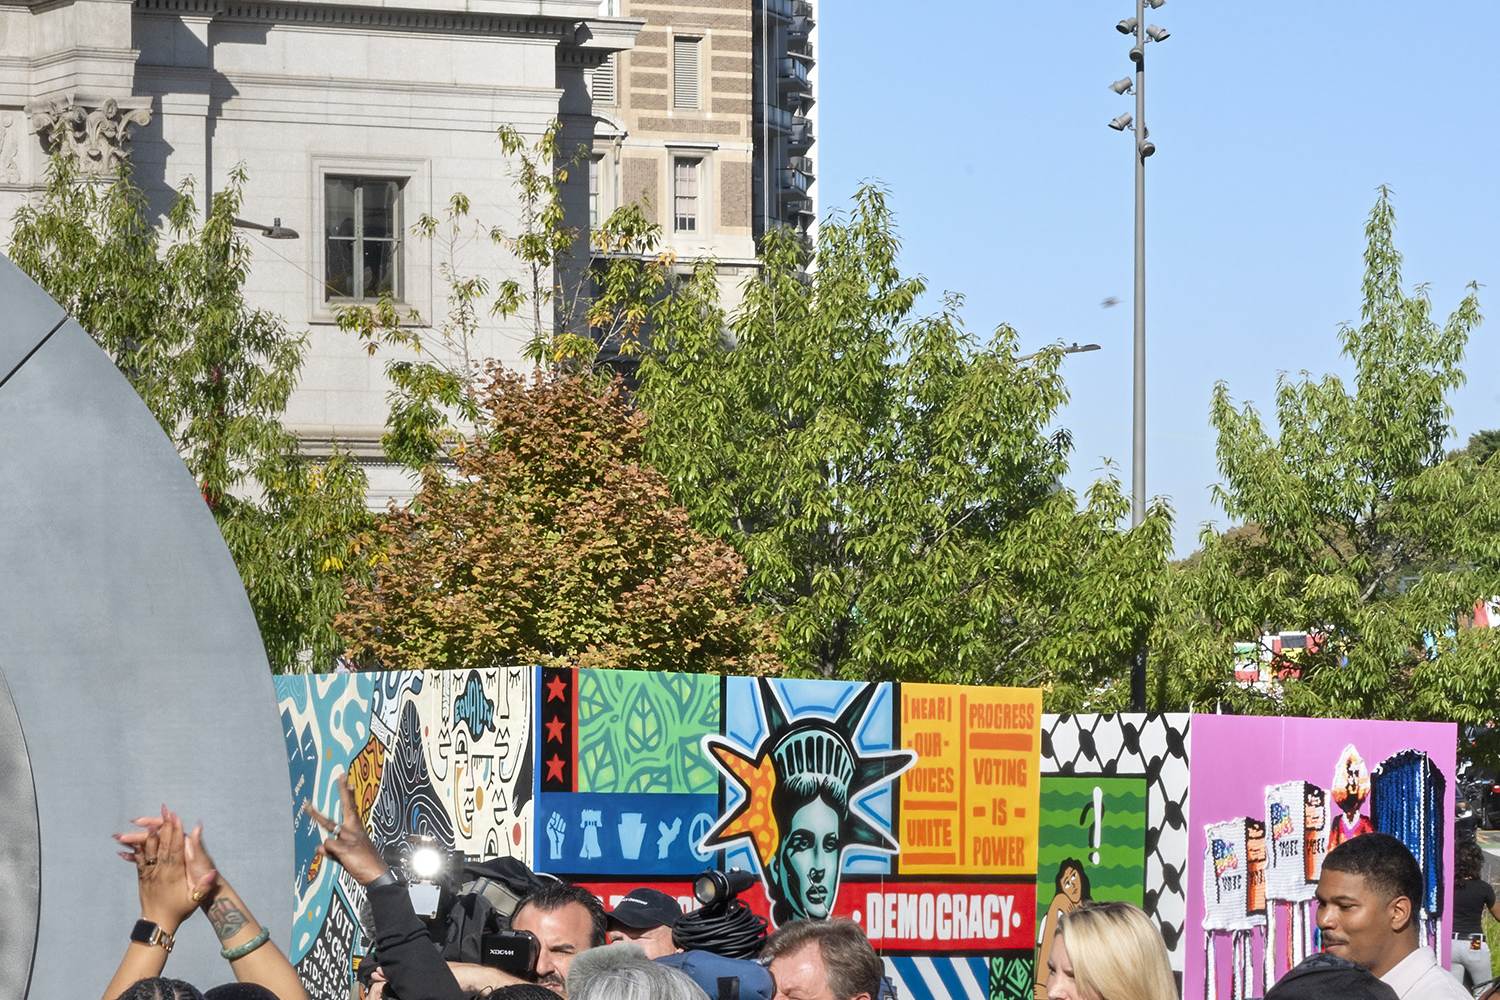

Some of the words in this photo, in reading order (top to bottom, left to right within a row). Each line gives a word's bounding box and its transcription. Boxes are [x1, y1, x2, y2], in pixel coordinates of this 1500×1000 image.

[911, 697, 946, 720] HEAR
[969, 703, 1035, 729] PROGRESS
[914, 732, 942, 757] OUR
[905, 767, 955, 793] VOICES
[973, 757, 1027, 788] VOTING
[991, 797, 1007, 826] IS
[906, 818, 952, 847] UNITE
[973, 836, 1025, 867] POWER
[331, 894, 354, 949] VOTE
[866, 892, 1015, 941] DEMOCRACY
[313, 938, 339, 986] SPACE
